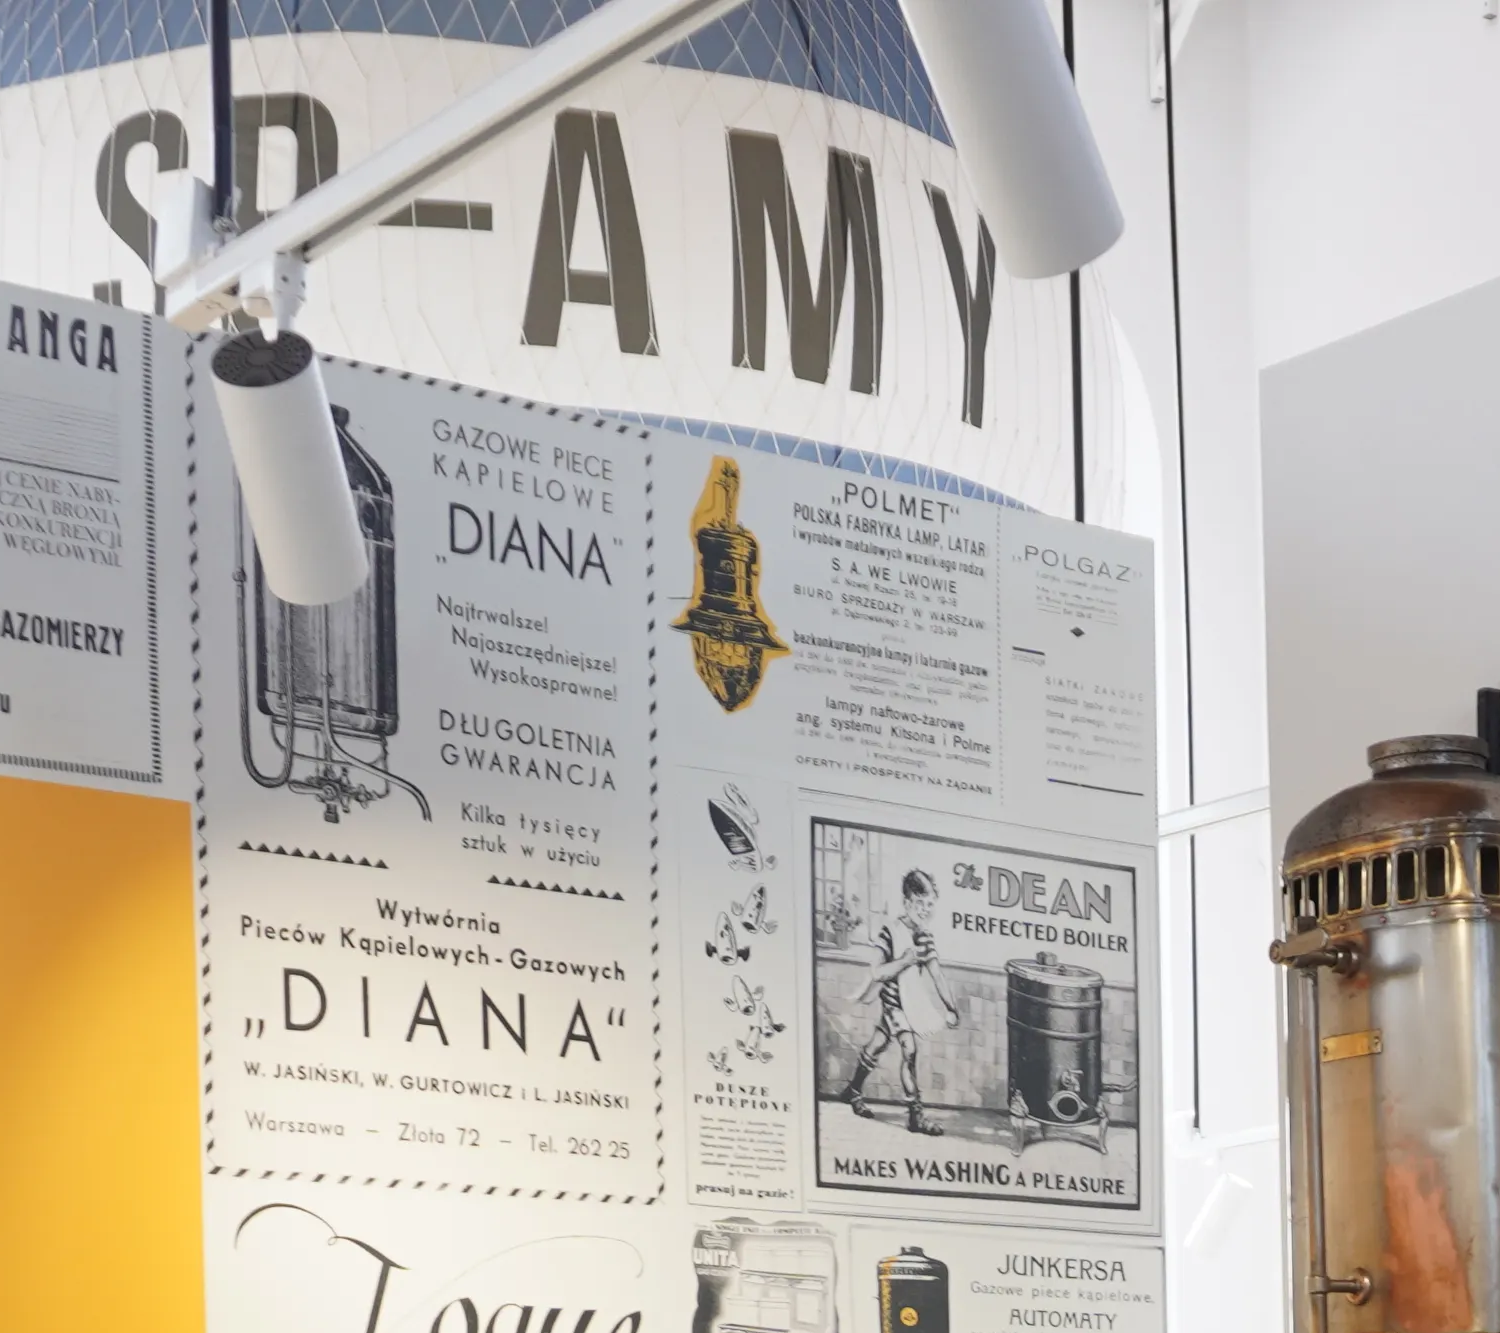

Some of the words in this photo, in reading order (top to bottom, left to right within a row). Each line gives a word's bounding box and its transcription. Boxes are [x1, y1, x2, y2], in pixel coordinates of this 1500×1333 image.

[432, 419, 540, 464] GAZOWE
[553, 447, 613, 481] PIECE
[5, 470, 62, 495] CENIE
[433, 453, 613, 514] KĄPIELOWE
[793, 502, 841, 528] POLSKA
[846, 514, 902, 541] FABRYKA
[907, 527, 943, 550] LAMP,
[793, 583, 833, 601] BIURO
[868, 564, 891, 581] WE
[900, 571, 957, 594] LWOWIE
[437, 594, 549, 634] Najtrwalsze!
[452, 625, 616, 674] Najoszczędniejsze!
[793, 630, 883, 659] bezkonkurencyjne
[470, 657, 617, 702] Wysokosprawne!
[440, 708, 615, 759] DŁUGOLETNIA
[825, 696, 864, 716] lampy
[870, 704, 965, 732] naftowo-żarowe
[830, 715, 882, 735] systemu
[891, 725, 935, 745] Kitsona
[440, 743, 616, 791] GWARANCJA
[853, 762, 923, 783] PROSPEKTY
[461, 802, 505, 828] Kilka
[519, 810, 601, 844] tysięcy
[461, 833, 507, 856] sztuk
[547, 845, 601, 869] użyciu
[952, 861, 984, 892] The
[988, 864, 1112, 924] DEAN
[376, 898, 501, 935] Wytwórnia
[952, 911, 1058, 944] PERFECTED
[1063, 927, 1129, 953] BOILER
[240, 914, 326, 947] Pieców
[340, 926, 490, 967] Kąpielowych
[509, 949, 626, 983] Gazowych
[243, 1060, 266, 1078] W.
[273, 1061, 365, 1088] JASIŃSKI,
[372, 1071, 395, 1089] W.
[401, 1075, 513, 1101] GURTOWICZ
[554, 1084, 630, 1110] JASIŃSKI
[244, 1110, 346, 1138] Warszawa
[398, 1122, 446, 1145] Złota
[456, 1129, 480, 1148] 72
[529, 1134, 558, 1155] Tel.
[567, 1137, 603, 1158] 262
[608, 1140, 631, 1160] 25
[834, 1156, 897, 1179] MAKES
[904, 1158, 1011, 1187] WASHING
[1032, 1170, 1125, 1196] PLEASURE
[996, 1254, 1127, 1282] JUNKERSA
[970, 1281, 1024, 1297] Gazowe
[1009, 1308, 1118, 1331] AUTOMATY
